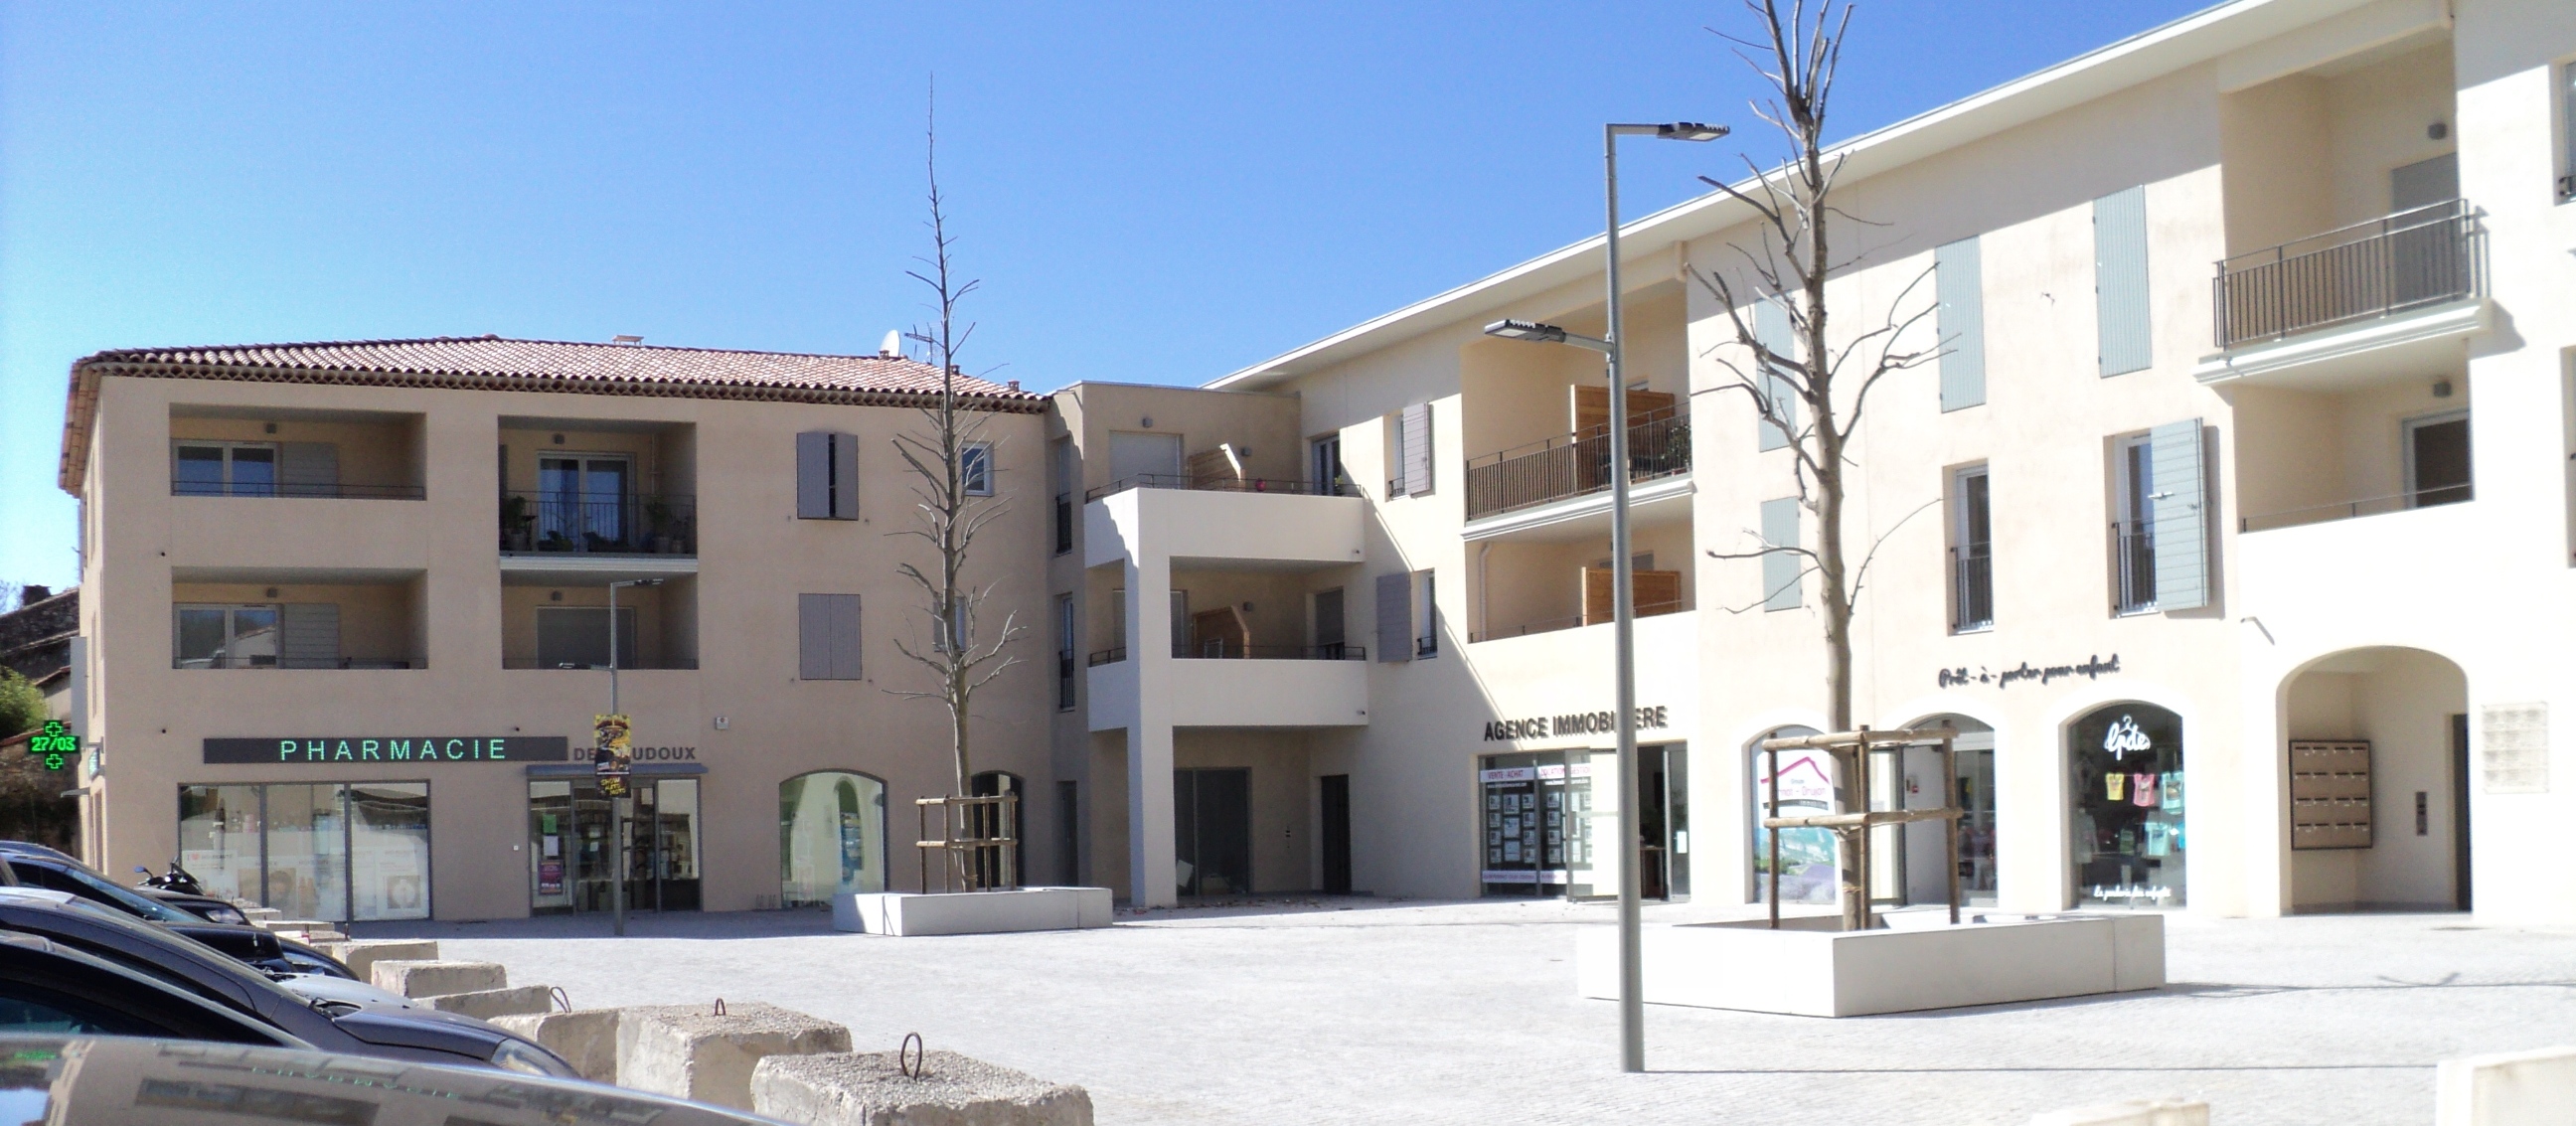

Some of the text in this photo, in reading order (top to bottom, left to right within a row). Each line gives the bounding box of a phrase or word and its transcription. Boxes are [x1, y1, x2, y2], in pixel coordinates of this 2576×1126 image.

[2075, 653, 2121, 681] enfant
[1484, 717, 1547, 741] AGENCE
[31, 736, 77, 751] 27/03
[280, 738, 506, 761] PHARMACIE
